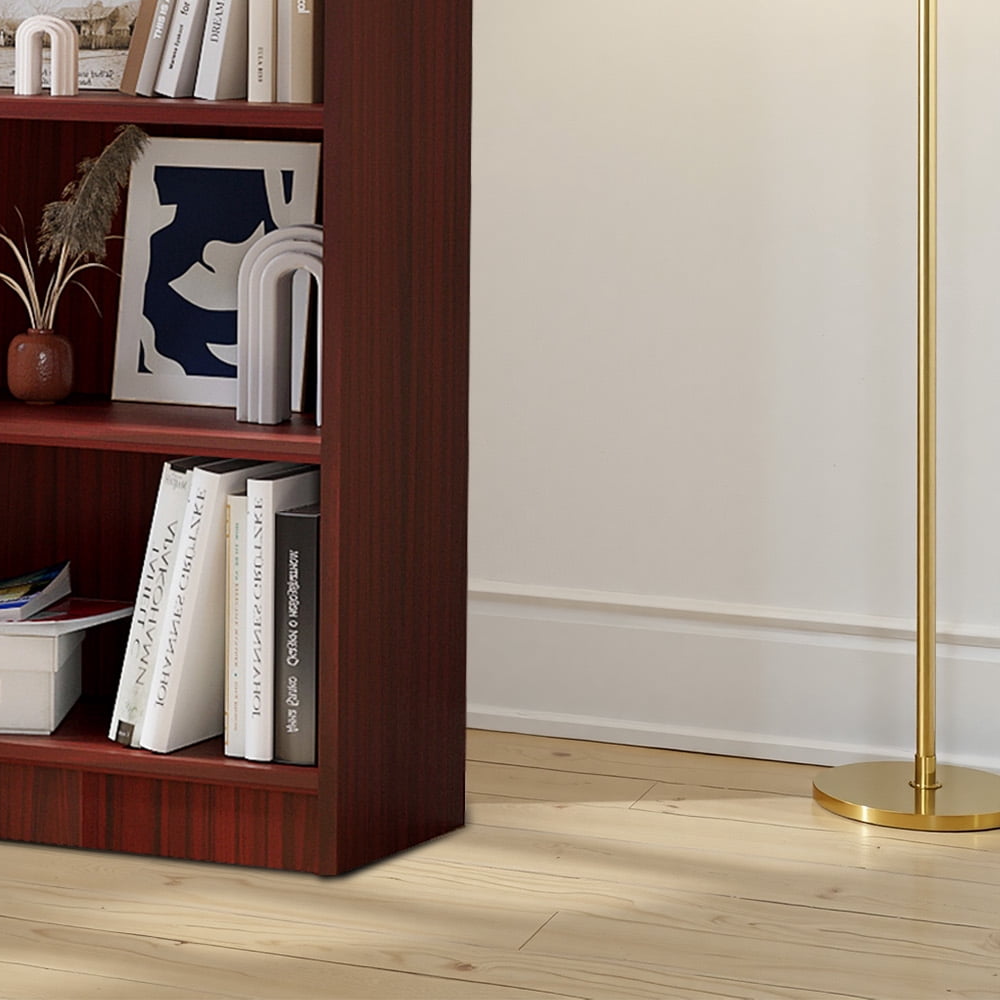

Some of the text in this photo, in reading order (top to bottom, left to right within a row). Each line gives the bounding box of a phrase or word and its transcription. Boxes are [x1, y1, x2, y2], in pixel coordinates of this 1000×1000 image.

[158, 3, 169, 16] IS
[180, 1, 190, 16] for
[153, 16, 164, 40] THIS
[210, 1, 224, 42] DREAM
